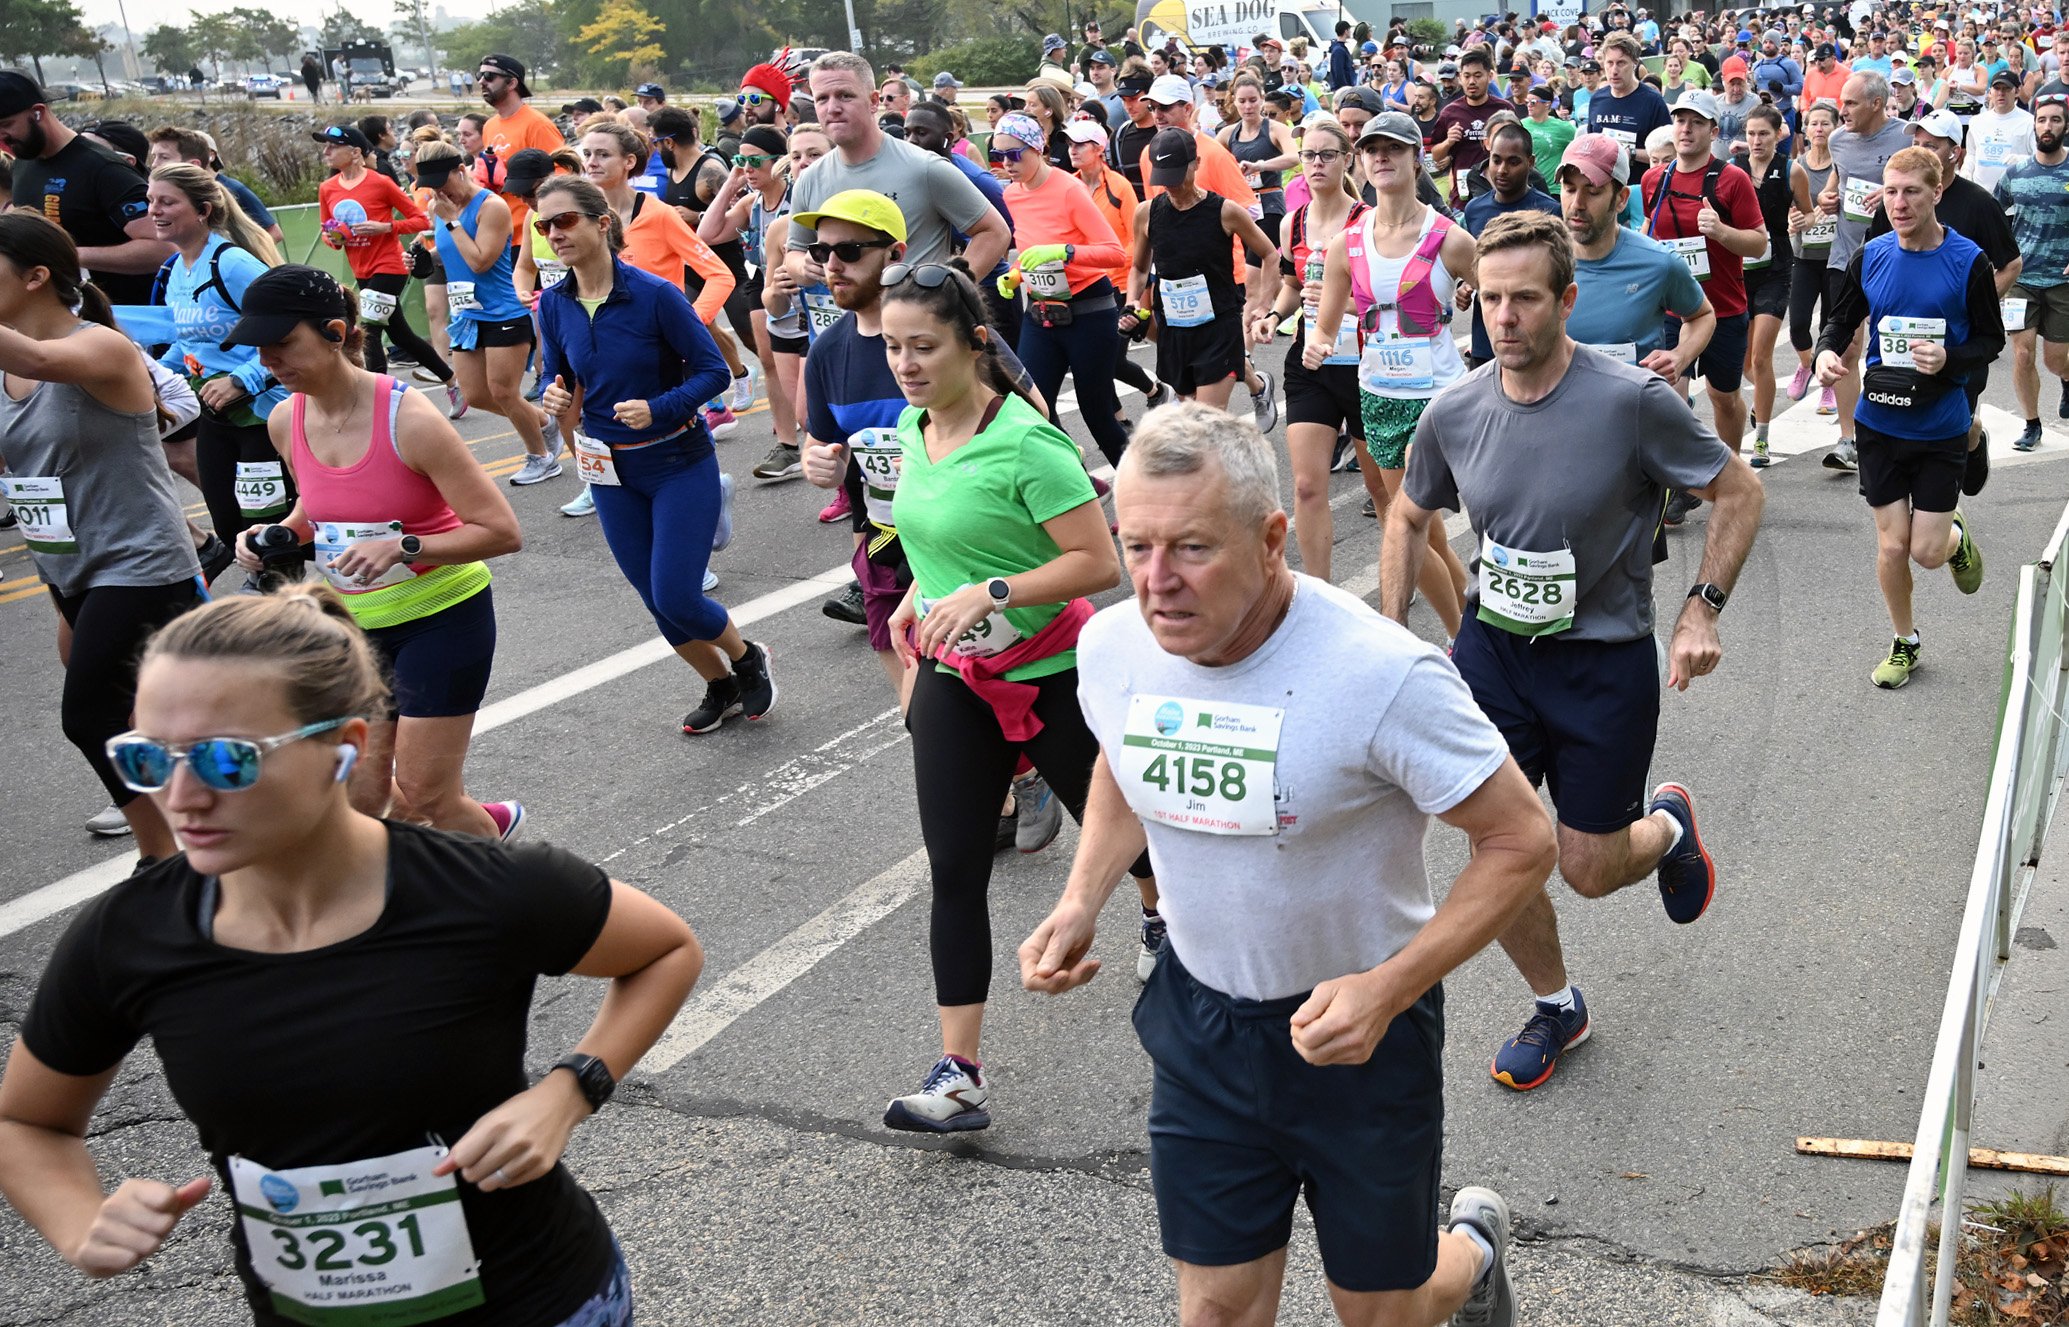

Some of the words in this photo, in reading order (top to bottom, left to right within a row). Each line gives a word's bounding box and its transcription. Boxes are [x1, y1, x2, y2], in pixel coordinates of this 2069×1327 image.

[1192, 4, 1228, 29] SEA
[1235, 0, 1275, 23] DOG
[1561, 8, 1579, 17] COVE
[1207, 27, 1243, 39] BREWING
[1984, 146, 2003, 155] 689
[1029, 274, 1056, 286] 3110
[361, 302, 390, 315] 3700
[1170, 295, 1198, 310] 578
[1883, 338, 1935, 353] 38
[1380, 349, 1414, 366] 1116
[1868, 392, 1912, 407] adidas
[1488, 571, 1562, 605] 2628
[1510, 601, 1535, 614] Jeffrey
[1214, 713, 1241, 723] Gorham
[1214, 722, 1239, 731] Savings
[1240, 724, 1257, 732] Bank
[1151, 738, 1177, 749] October
[1142, 754, 1247, 802] 4158
[1186, 799, 1206, 812] Jim
[1169, 813, 1189, 822] HALF
[1193, 816, 1241, 830] MARATHON
[271, 1213, 425, 1272] 3231
[319, 1271, 387, 1287] Marissa
[304, 1290, 333, 1301] HALF
[337, 1282, 412, 1300] MARATHON
